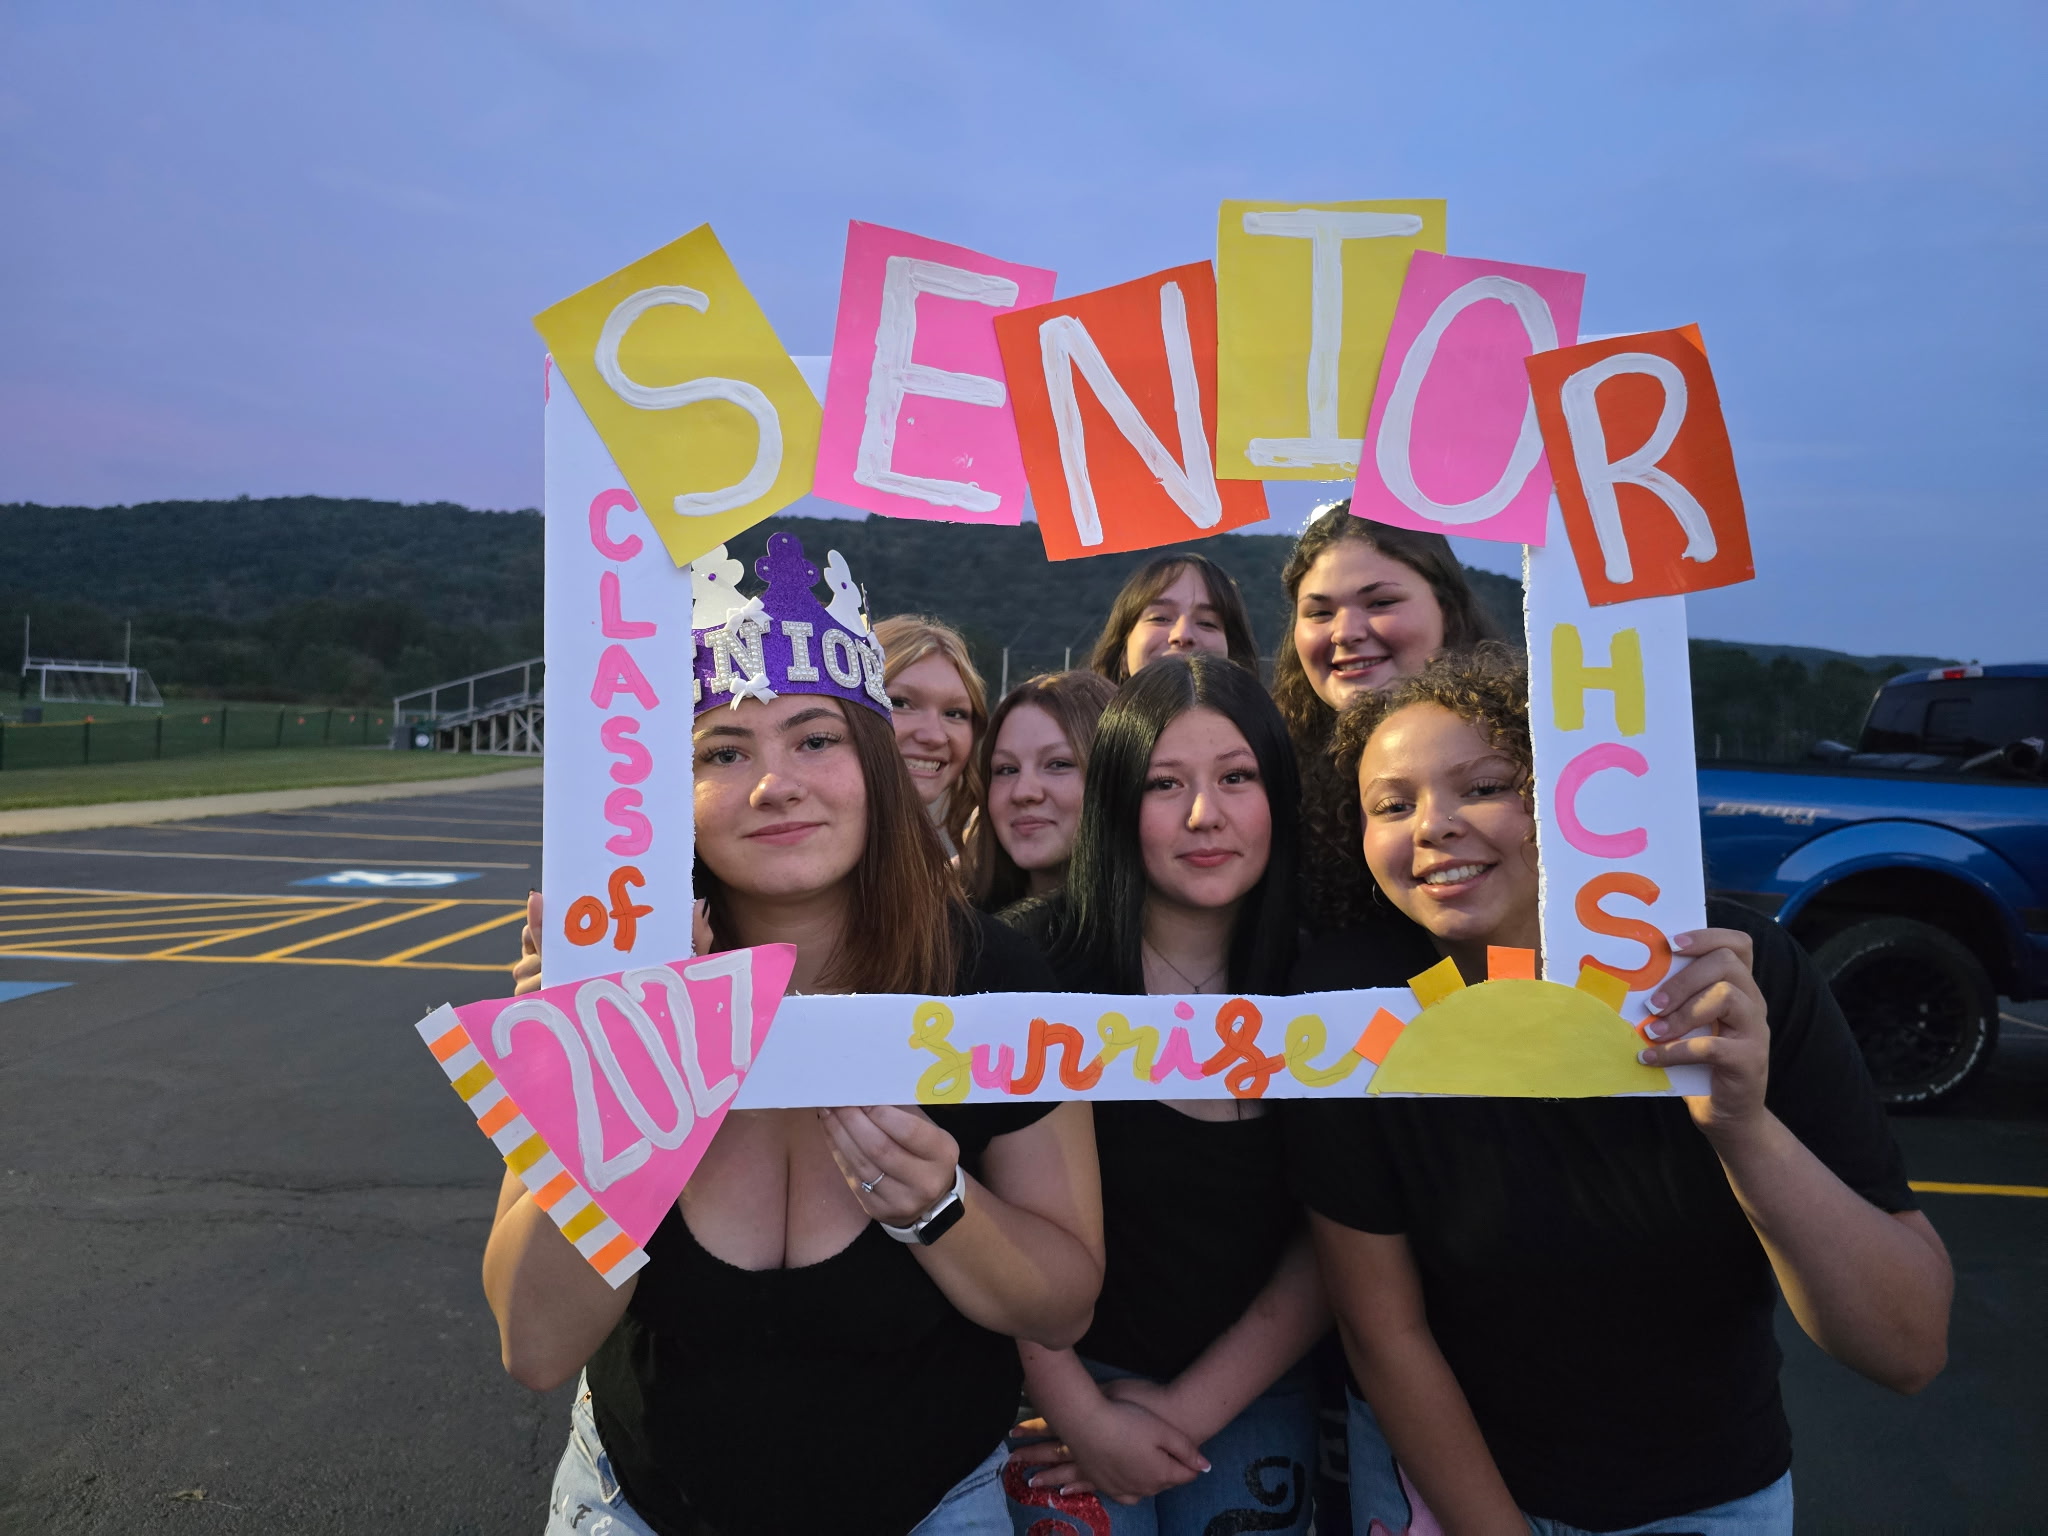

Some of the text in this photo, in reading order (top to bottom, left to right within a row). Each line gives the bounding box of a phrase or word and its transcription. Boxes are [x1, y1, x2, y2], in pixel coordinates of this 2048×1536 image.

[595, 209, 1717, 584] SENIOR
[564, 489, 660, 953] CLASS of
[692, 620, 893, 711] NIOR
[1552, 623, 1672, 991] HCS
[492, 949, 752, 1192] 2027
